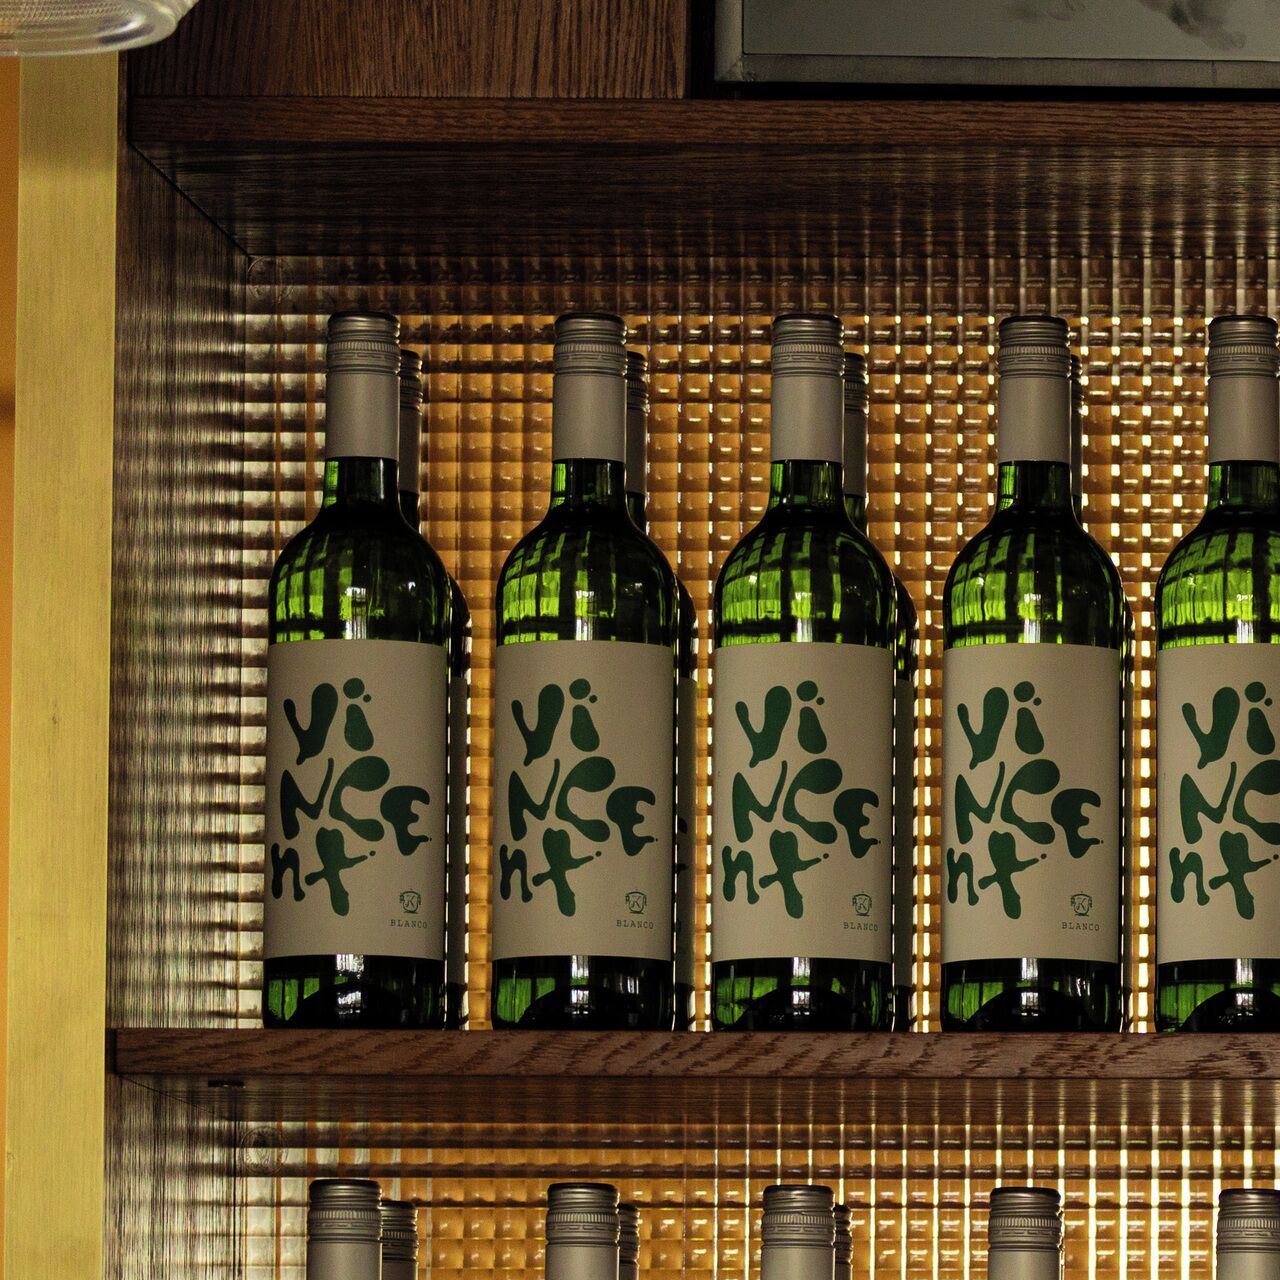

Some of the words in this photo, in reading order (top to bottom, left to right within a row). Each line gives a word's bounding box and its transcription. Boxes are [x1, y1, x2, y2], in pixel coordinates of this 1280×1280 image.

[389, 918, 428, 930] BLANCO
[615, 919, 655, 931] BLANCO
[842, 921, 879, 933] BLANCO
[1061, 921, 1101, 933] BLANCO
